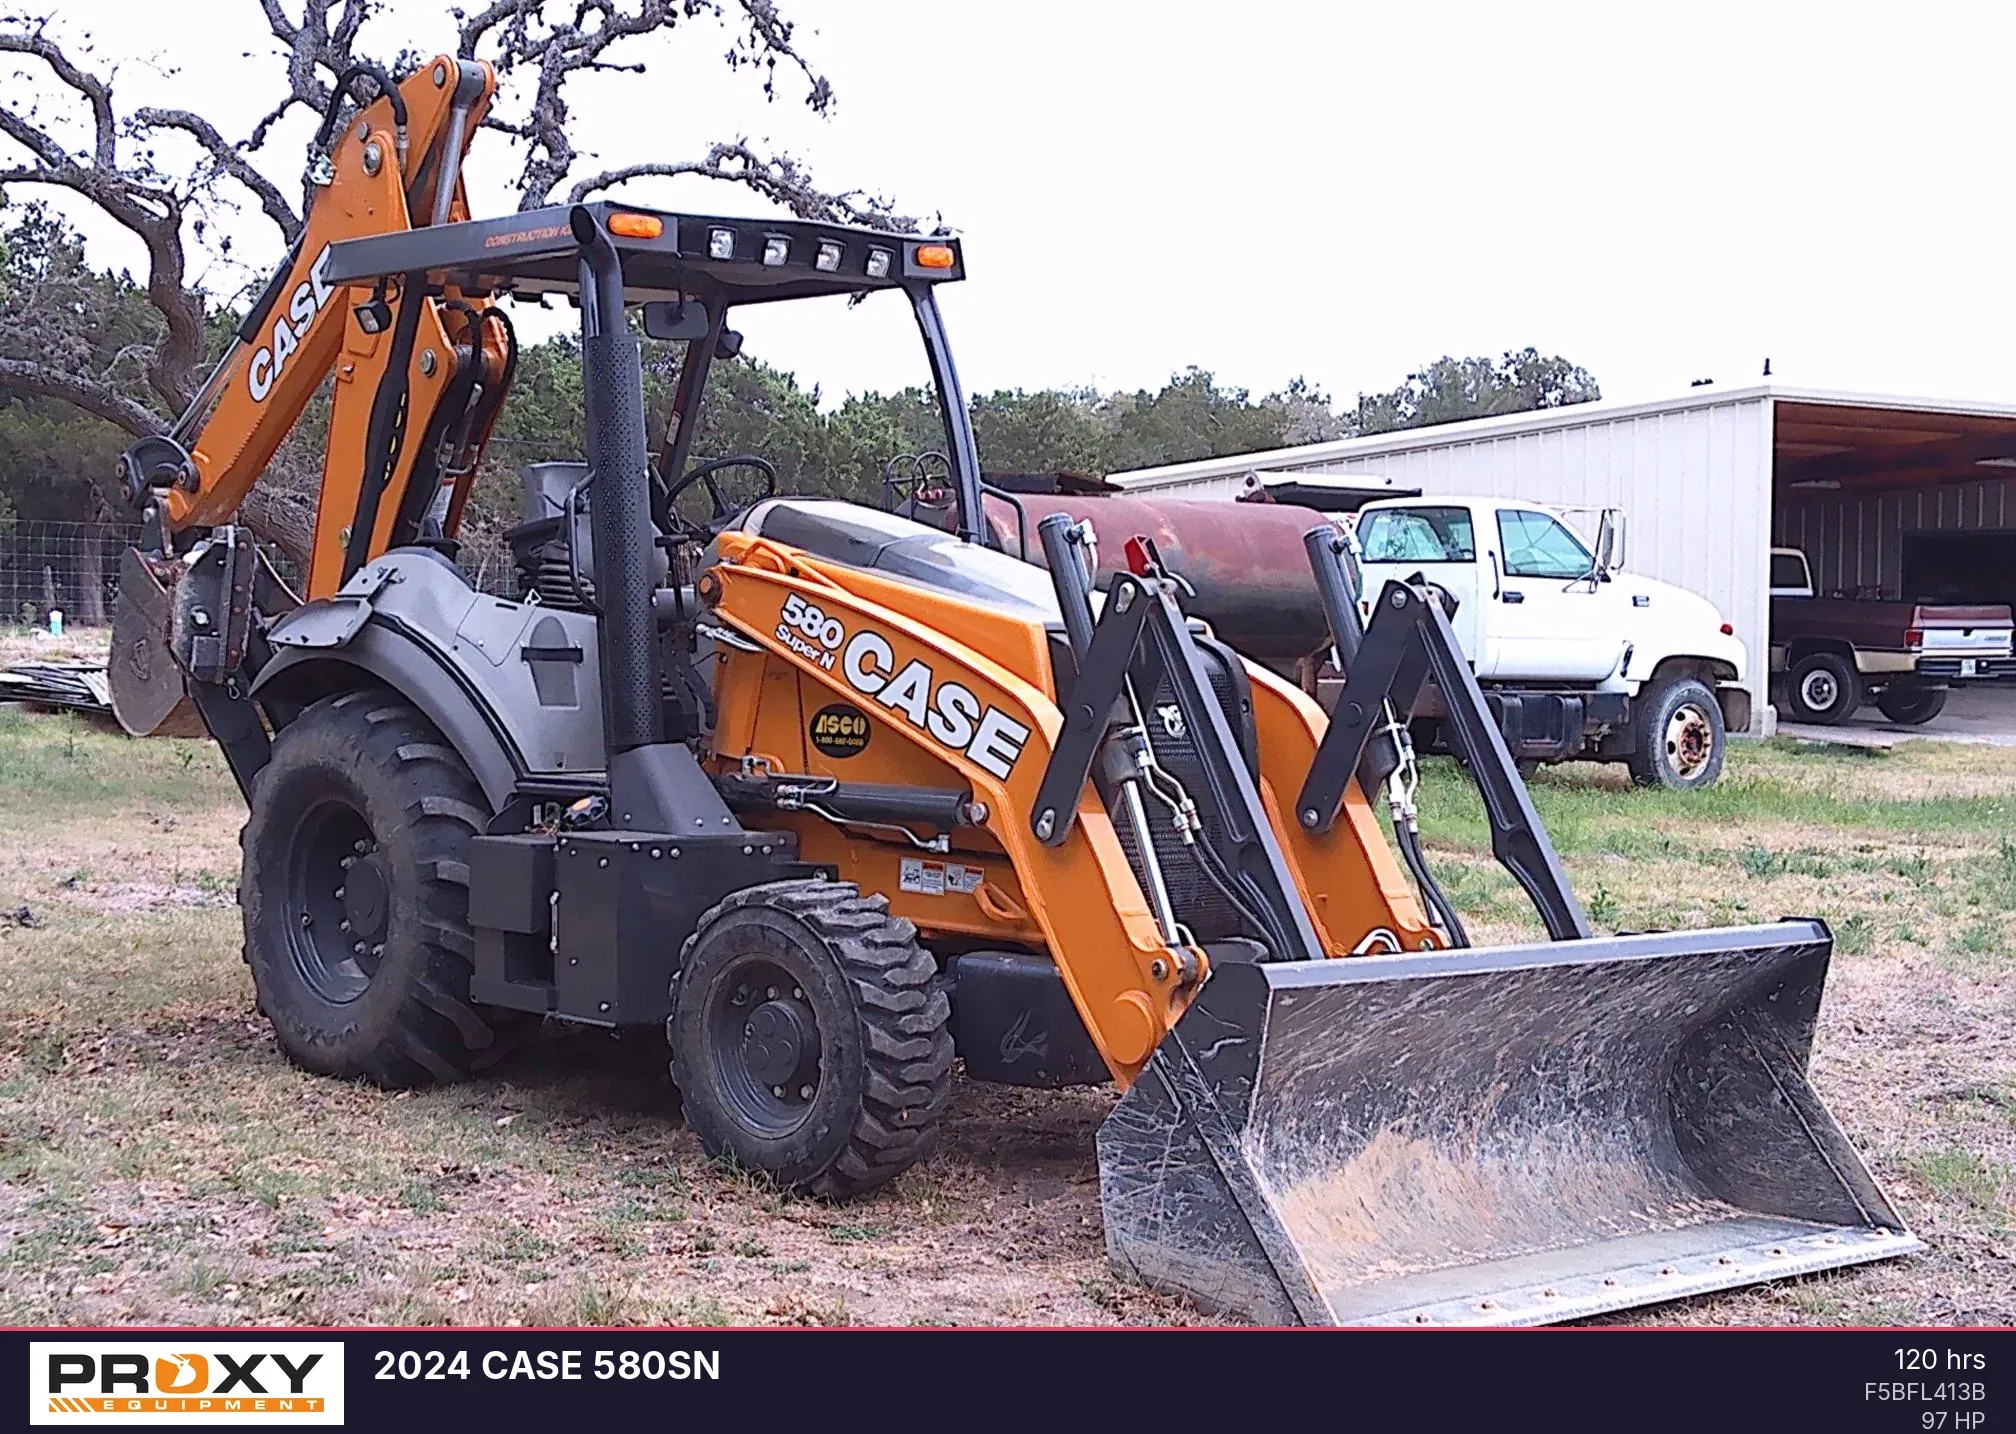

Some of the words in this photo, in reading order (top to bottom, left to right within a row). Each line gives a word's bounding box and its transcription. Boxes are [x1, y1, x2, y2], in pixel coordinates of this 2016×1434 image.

[248, 241, 337, 403] CASE
[775, 622, 821, 661] Super
[818, 651, 837, 671] N
[781, 592, 845, 651] 580
[815, 714, 866, 735] ASCO
[843, 630, 1032, 781] CASE
